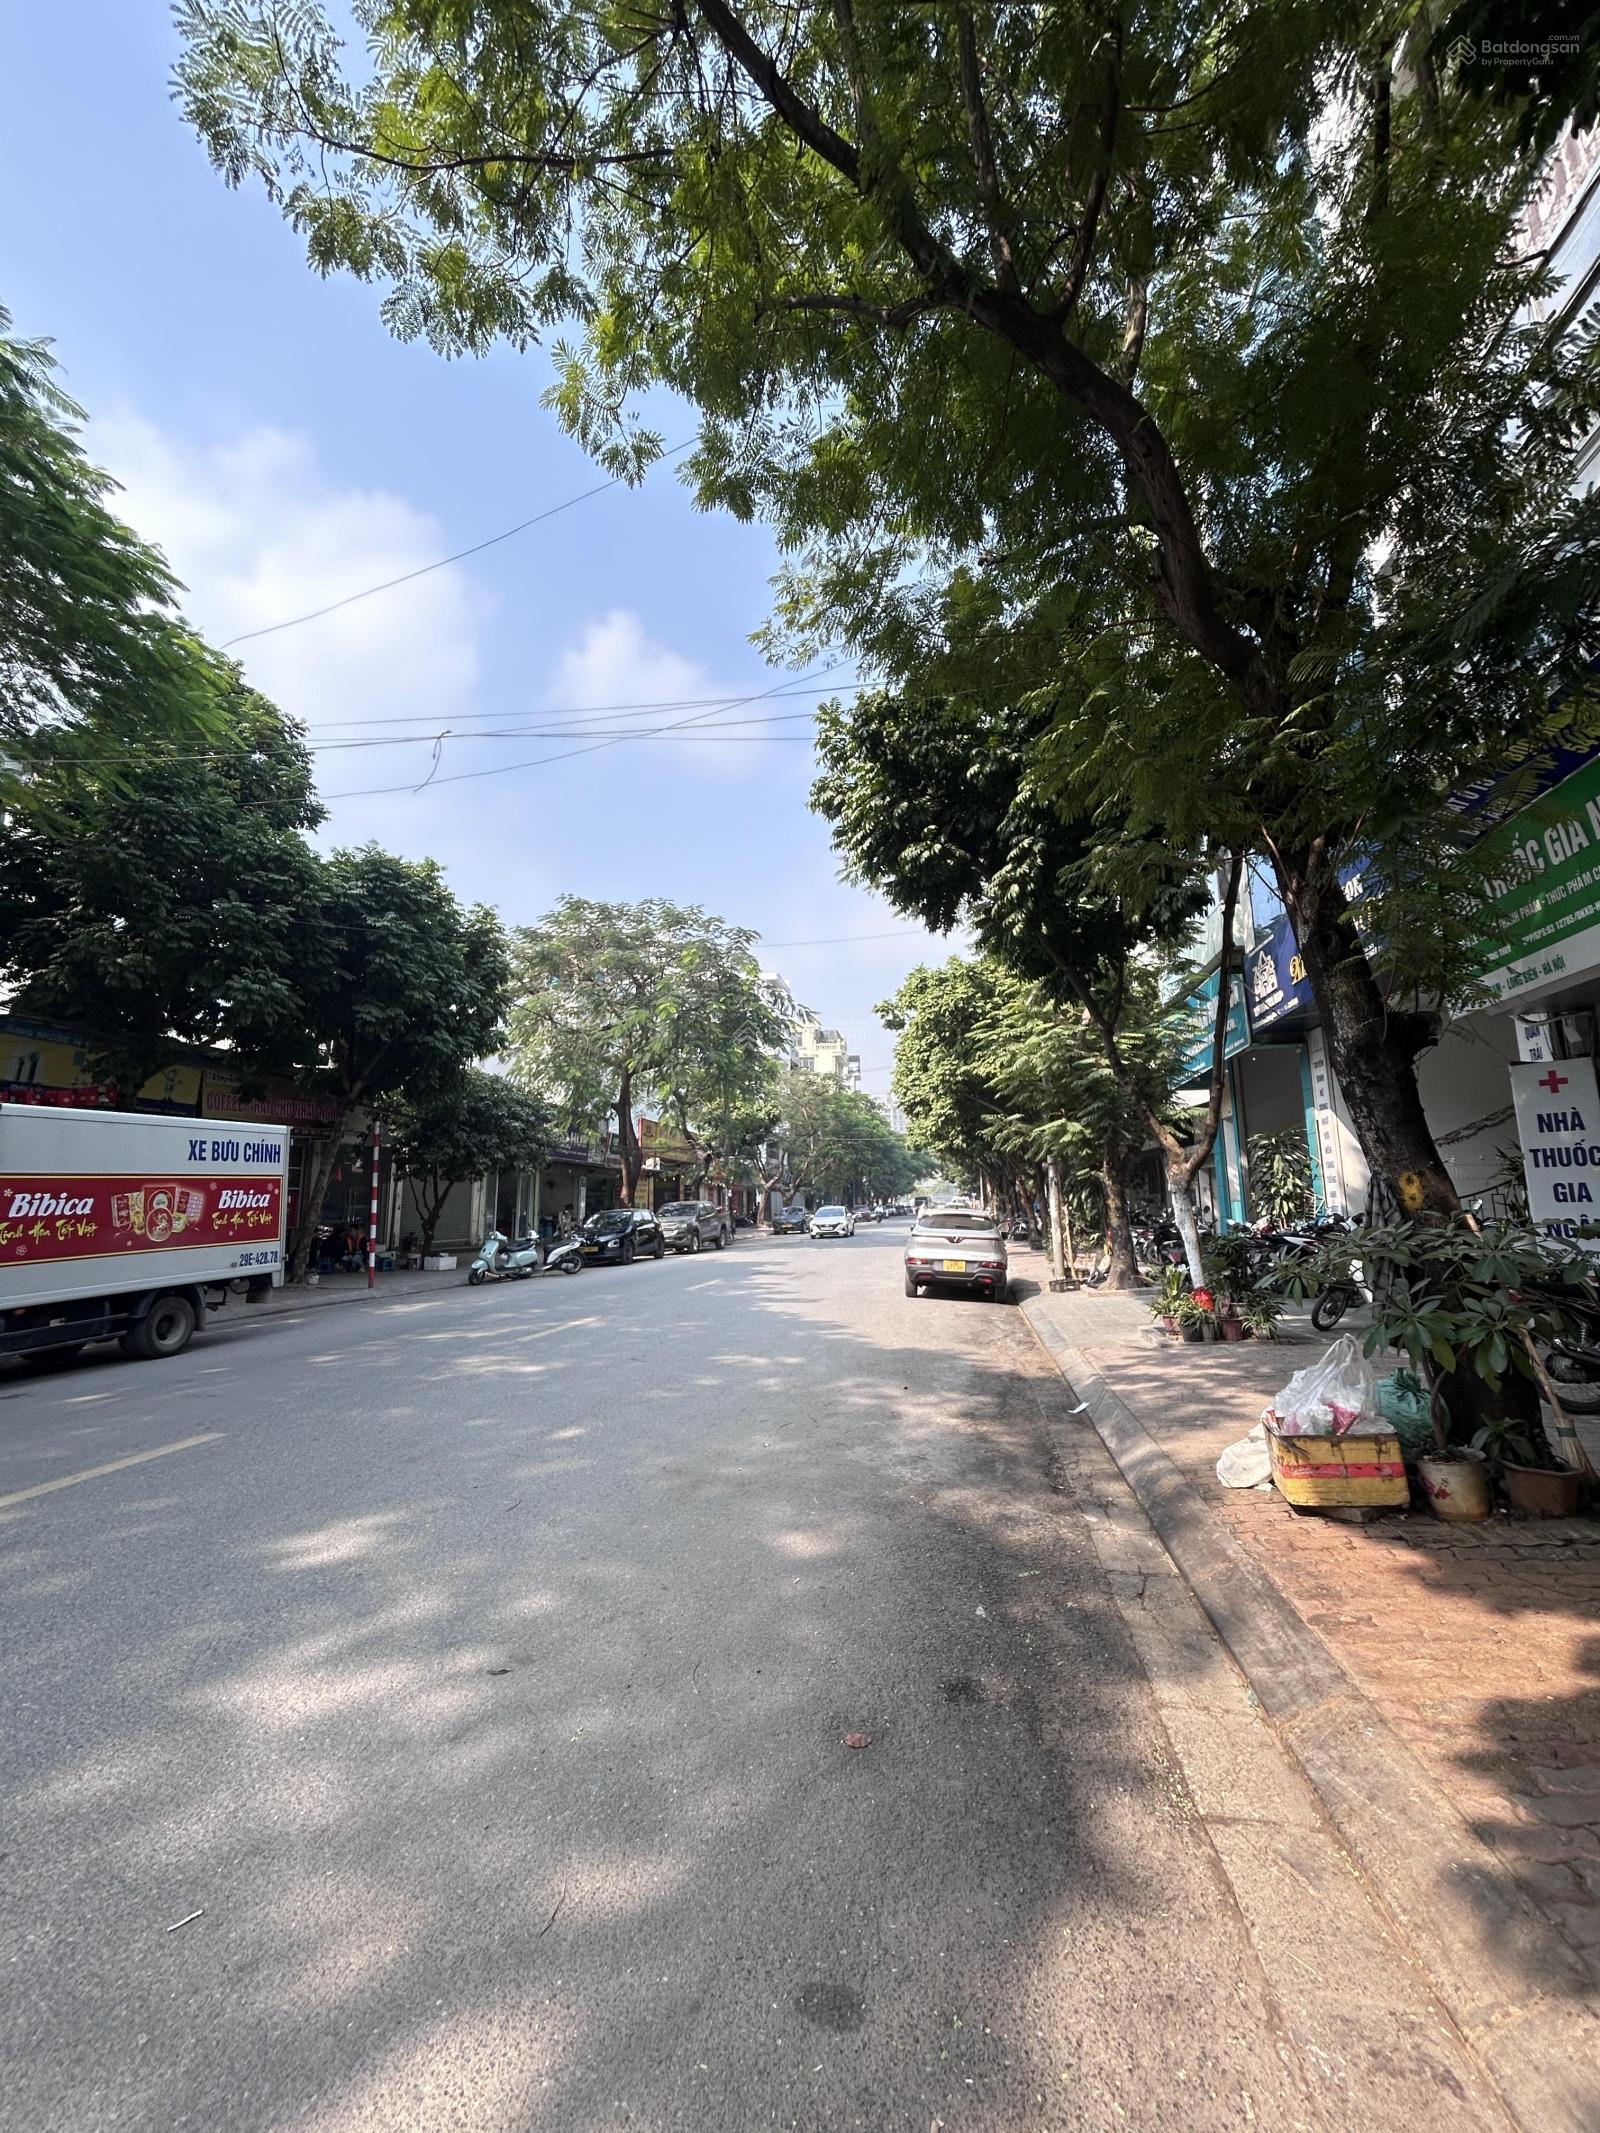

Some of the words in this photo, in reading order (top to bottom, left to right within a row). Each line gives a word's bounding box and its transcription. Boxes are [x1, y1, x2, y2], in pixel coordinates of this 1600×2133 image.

[1543, 820, 1590, 866] GIA
[1541, 959, 1553, 975] HÀ
[1552, 954, 1566, 973] NỘI
[1536, 1106, 1586, 1133] NHÀ
[188, 1139, 207, 1161] XE
[211, 1139, 240, 1162] BƯU
[243, 1138, 281, 1163] CHÍNH
[1529, 1138, 1600, 1168] THUỐC
[8, 1192, 94, 1218] Bibica
[218, 1189, 270, 1209] Bibica
[1552, 1182, 1594, 1203] GIA
[239, 1250, 279, 1267] 29E-428.78
